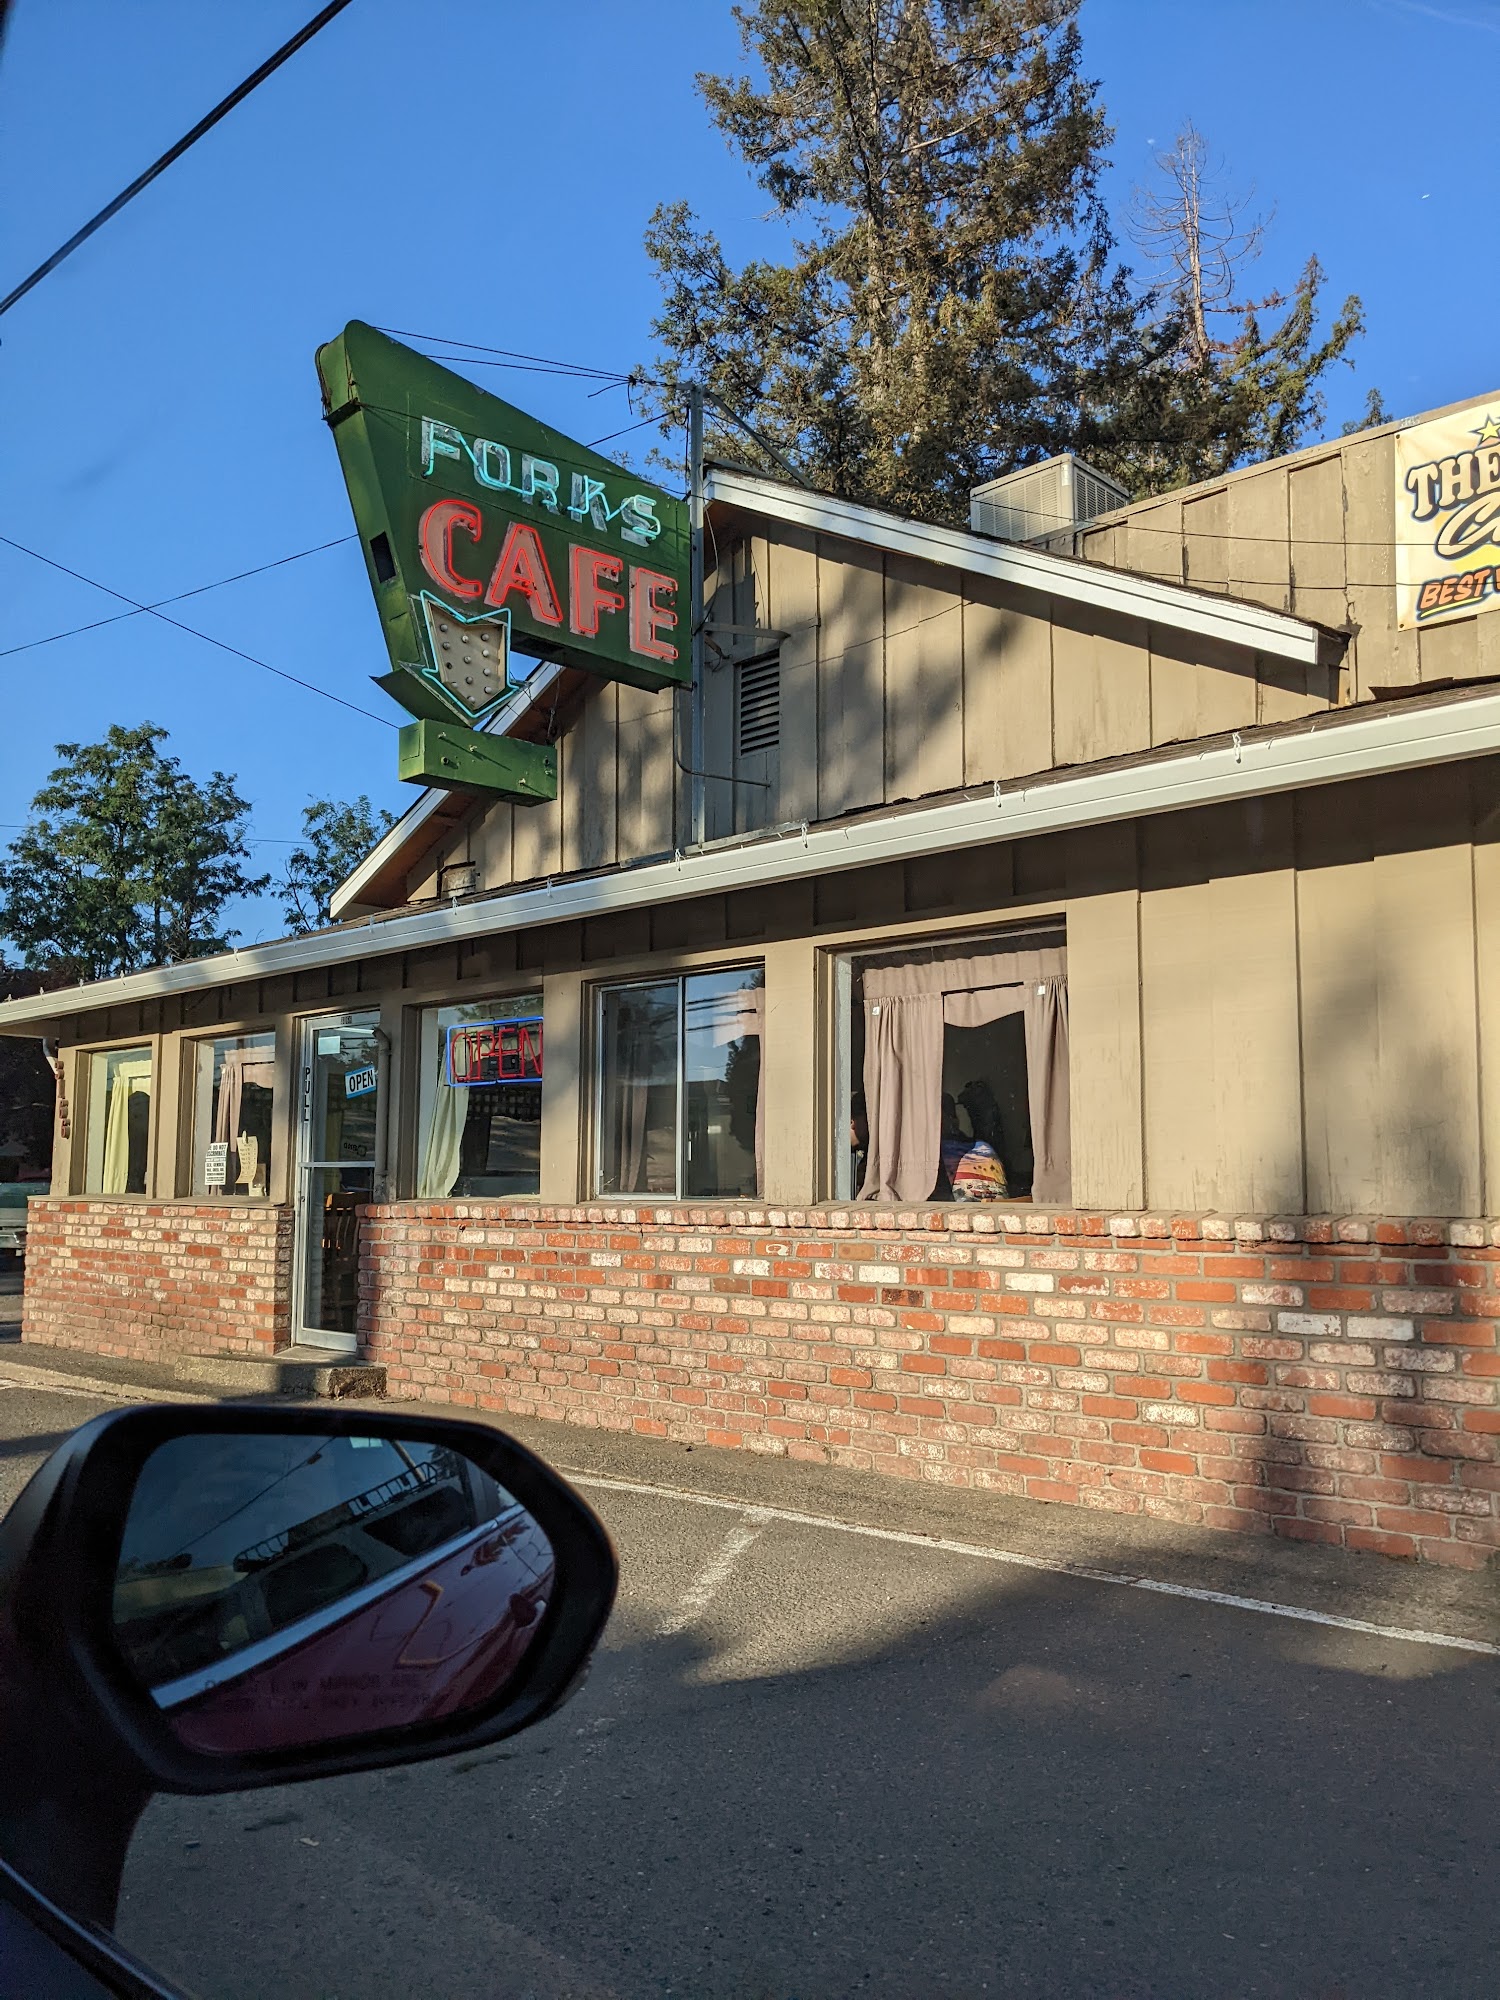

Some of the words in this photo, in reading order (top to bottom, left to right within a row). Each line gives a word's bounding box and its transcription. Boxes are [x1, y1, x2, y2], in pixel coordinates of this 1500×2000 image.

[421, 415, 661, 547] FORKS
[418, 499, 679, 665] CAFE
[1418, 568, 1493, 611] BEST
[451, 1023, 543, 1081] OPEN
[303, 1066, 311, 1121] PULL
[349, 1069, 374, 1092] OPEN
